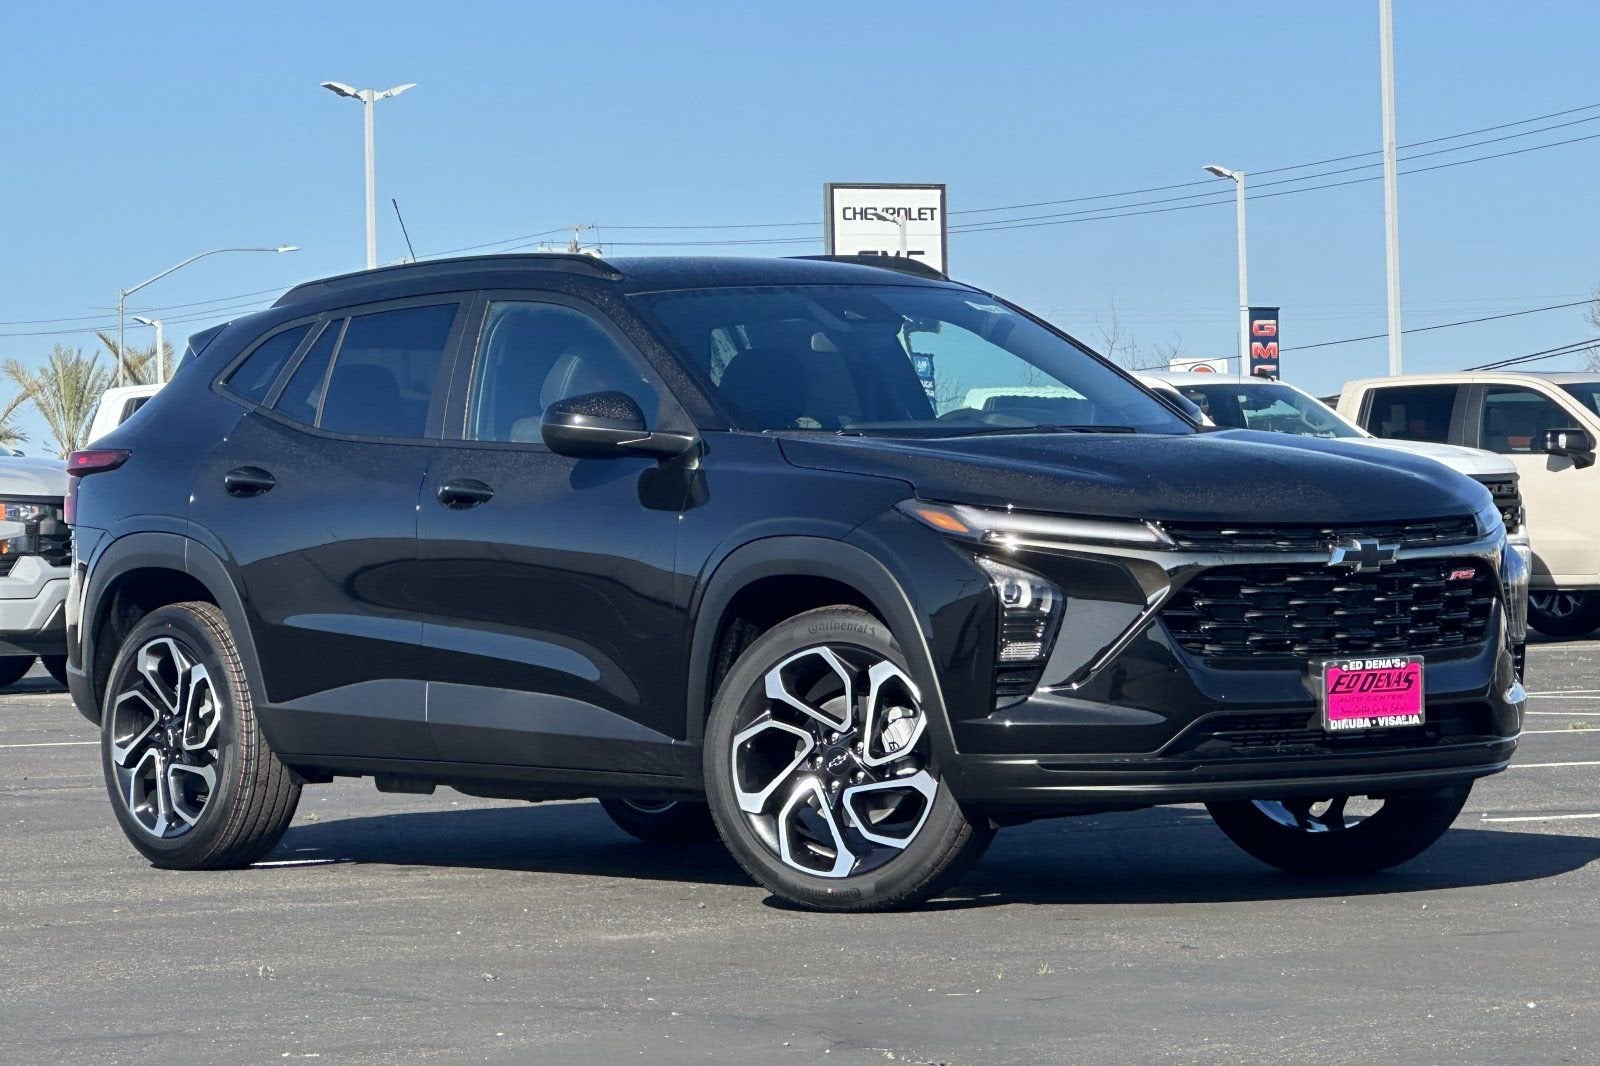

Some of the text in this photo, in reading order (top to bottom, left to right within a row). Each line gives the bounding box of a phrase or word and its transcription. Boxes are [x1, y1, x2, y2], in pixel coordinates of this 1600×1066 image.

[842, 207, 937, 221] CHEROLET
[1449, 569, 1476, 581] RS
[1349, 660, 1363, 670] ED
